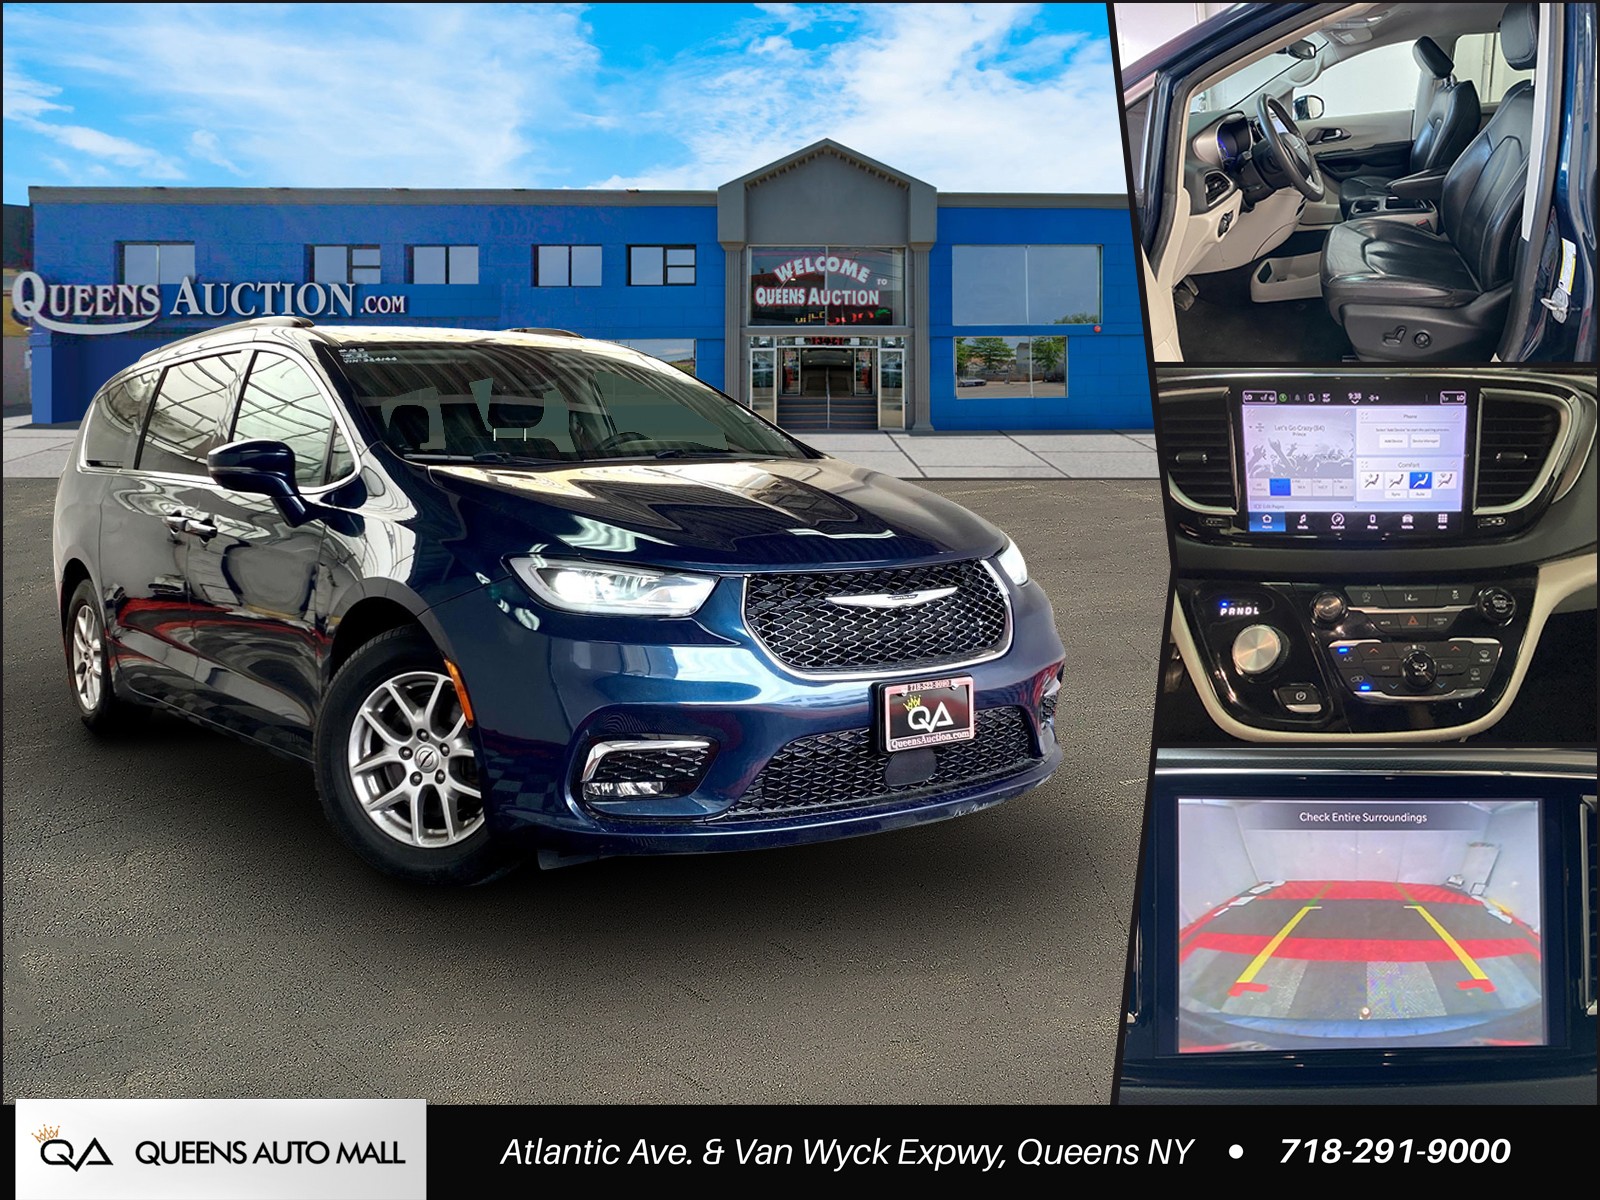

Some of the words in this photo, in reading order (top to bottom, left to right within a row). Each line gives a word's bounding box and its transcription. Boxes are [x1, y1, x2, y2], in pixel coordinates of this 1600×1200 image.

[773, 256, 871, 284] WELCOME
[12, 271, 162, 335] QUEENS
[755, 286, 806, 306] QUEENS
[807, 287, 880, 305] AUCTION
[1298, 425, 1313, 433] Crazy
[891, 731, 970, 749] QueensAuction.com
[1299, 811, 1331, 822] Check
[1332, 812, 1361, 822] Entire
[1362, 812, 1428, 824] Surroundings
